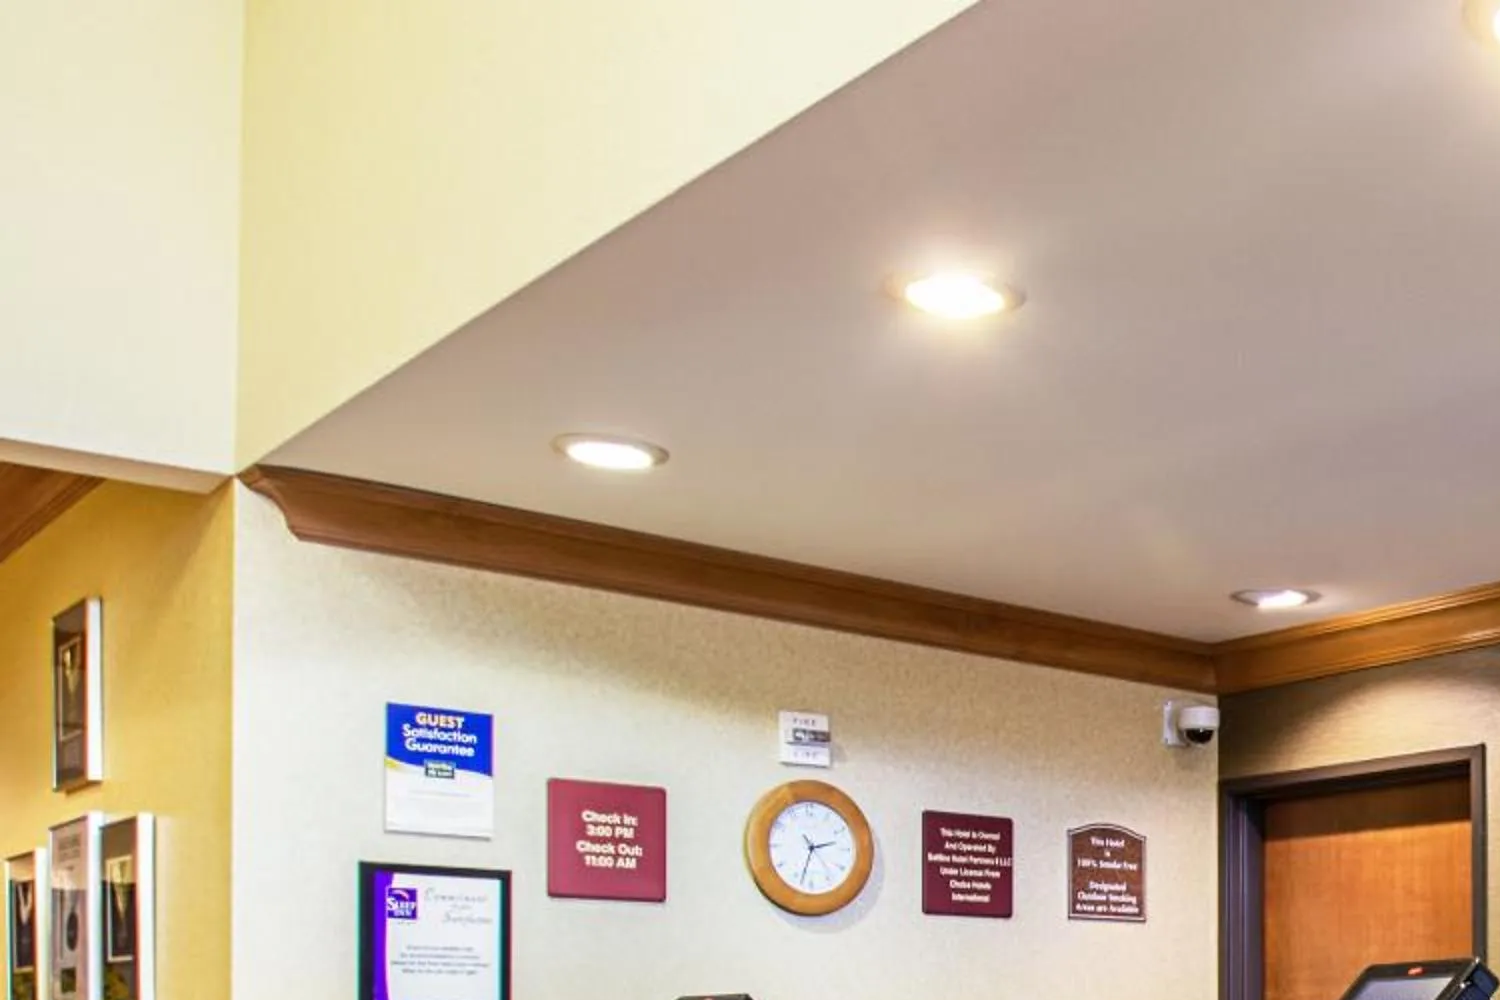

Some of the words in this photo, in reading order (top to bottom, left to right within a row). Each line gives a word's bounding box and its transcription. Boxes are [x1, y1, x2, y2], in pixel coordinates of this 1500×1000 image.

[415, 711, 465, 728] GUEST
[402, 723, 478, 744] Satisfaction
[404, 737, 475, 757] Guarantee
[581, 810, 621, 825] Check
[586, 824, 613, 837] 3:00
[614, 827, 635, 839] PM
[575, 839, 616, 855] Check
[584, 855, 614, 869] 11:00
[615, 857, 637, 870] AM
